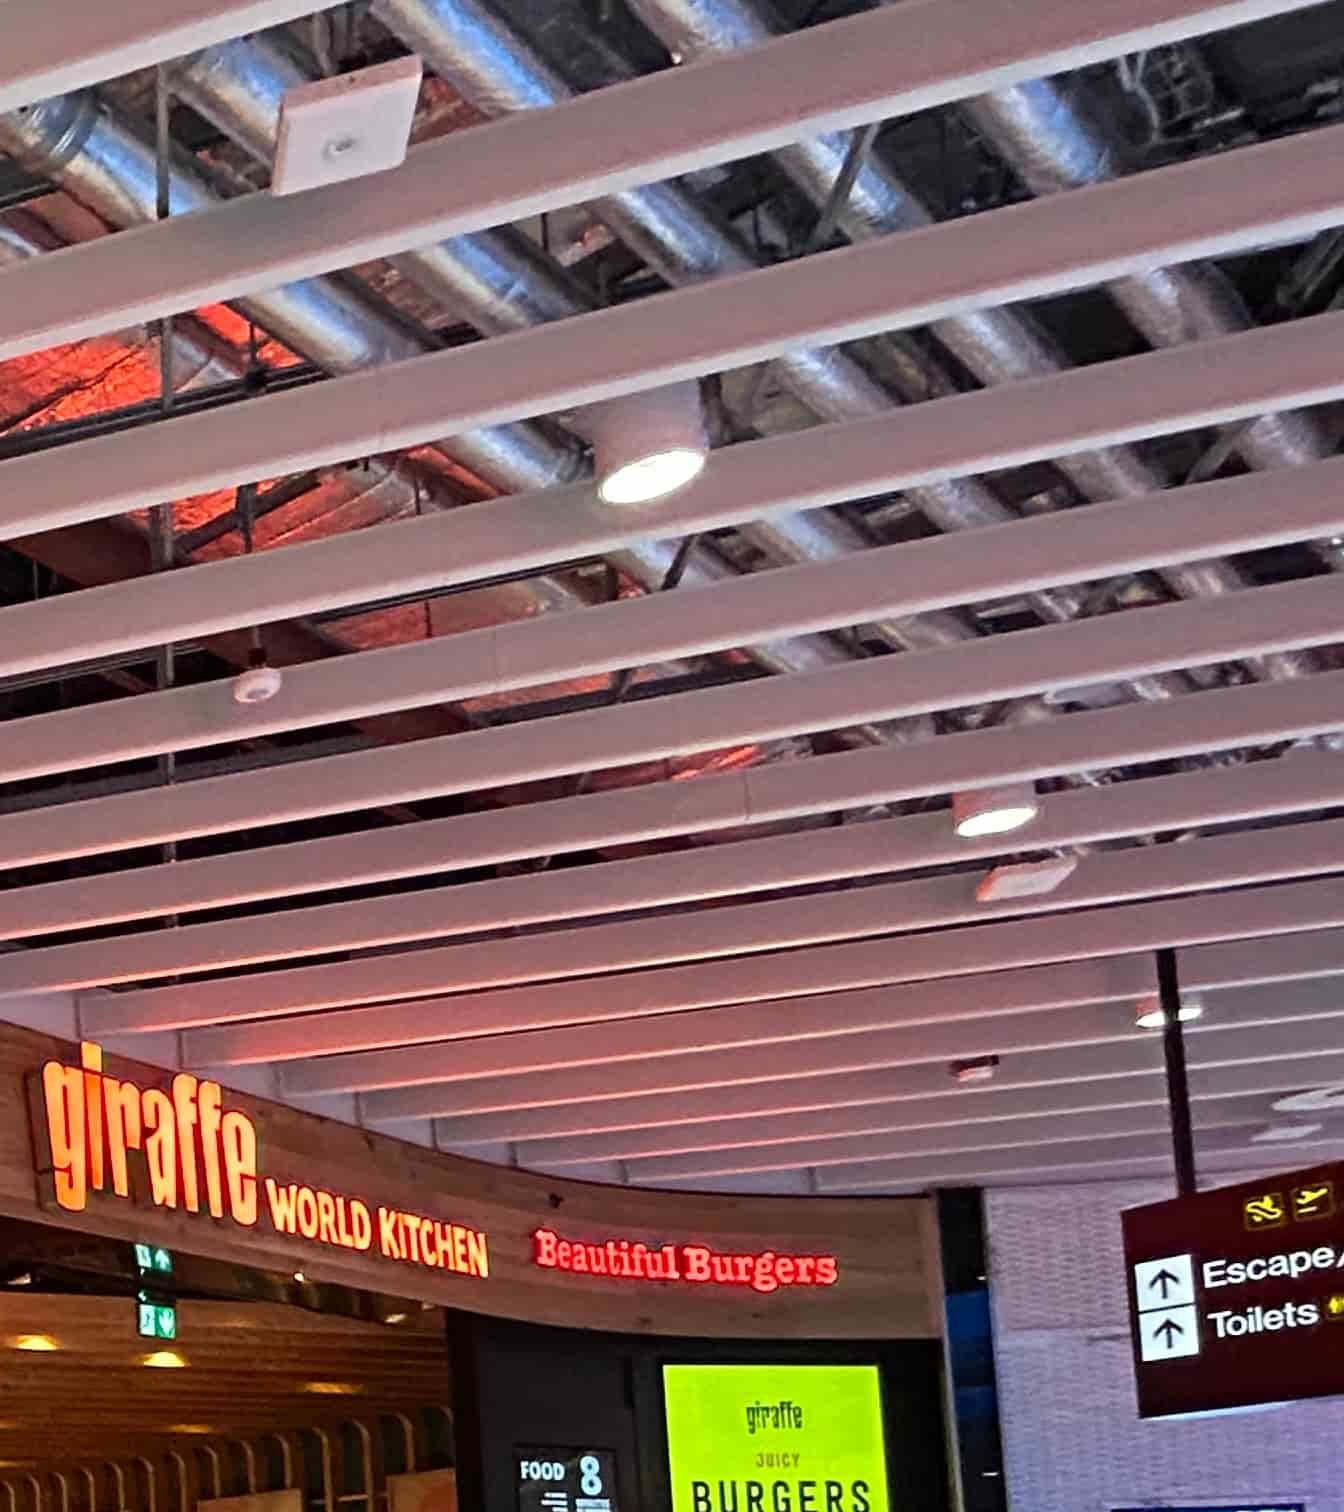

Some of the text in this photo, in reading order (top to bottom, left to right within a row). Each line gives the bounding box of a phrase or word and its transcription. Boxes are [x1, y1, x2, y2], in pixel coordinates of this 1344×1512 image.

[42, 1040, 259, 1226] giraffe
[265, 1177, 490, 1279] WORLD KITCHEN
[534, 1228, 838, 1290] Beautiful Burgers
[1207, 1302, 1320, 1338] Toilets
[745, 1401, 803, 1435] giraffe
[520, 1455, 603, 1496] FOOD 8
[755, 1453, 801, 1468] JUICY
